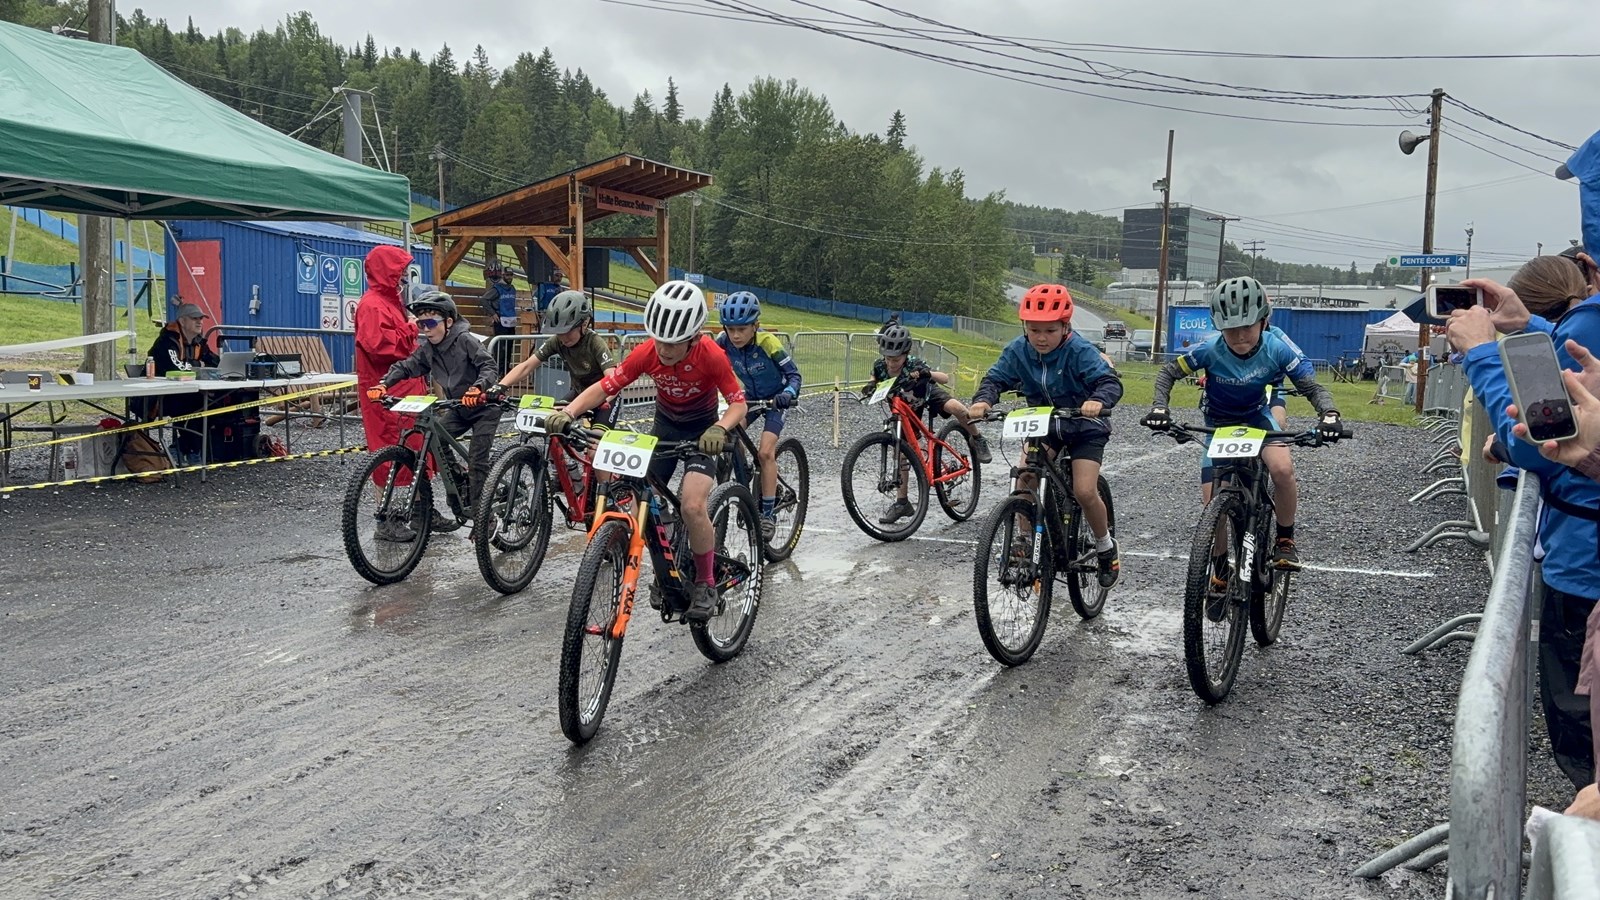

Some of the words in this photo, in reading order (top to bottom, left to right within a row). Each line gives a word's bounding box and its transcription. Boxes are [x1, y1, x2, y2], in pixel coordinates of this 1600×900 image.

[1401, 257, 1425, 265] PENTE
[1426, 256, 1450, 264] ÉCOLE
[1180, 316, 1208, 330] ÉCOLE
[1012, 420, 1039, 433] 115
[1216, 443, 1253, 454] 108
[603, 449, 642, 470] 100
[623, 587, 636, 615] FOX
